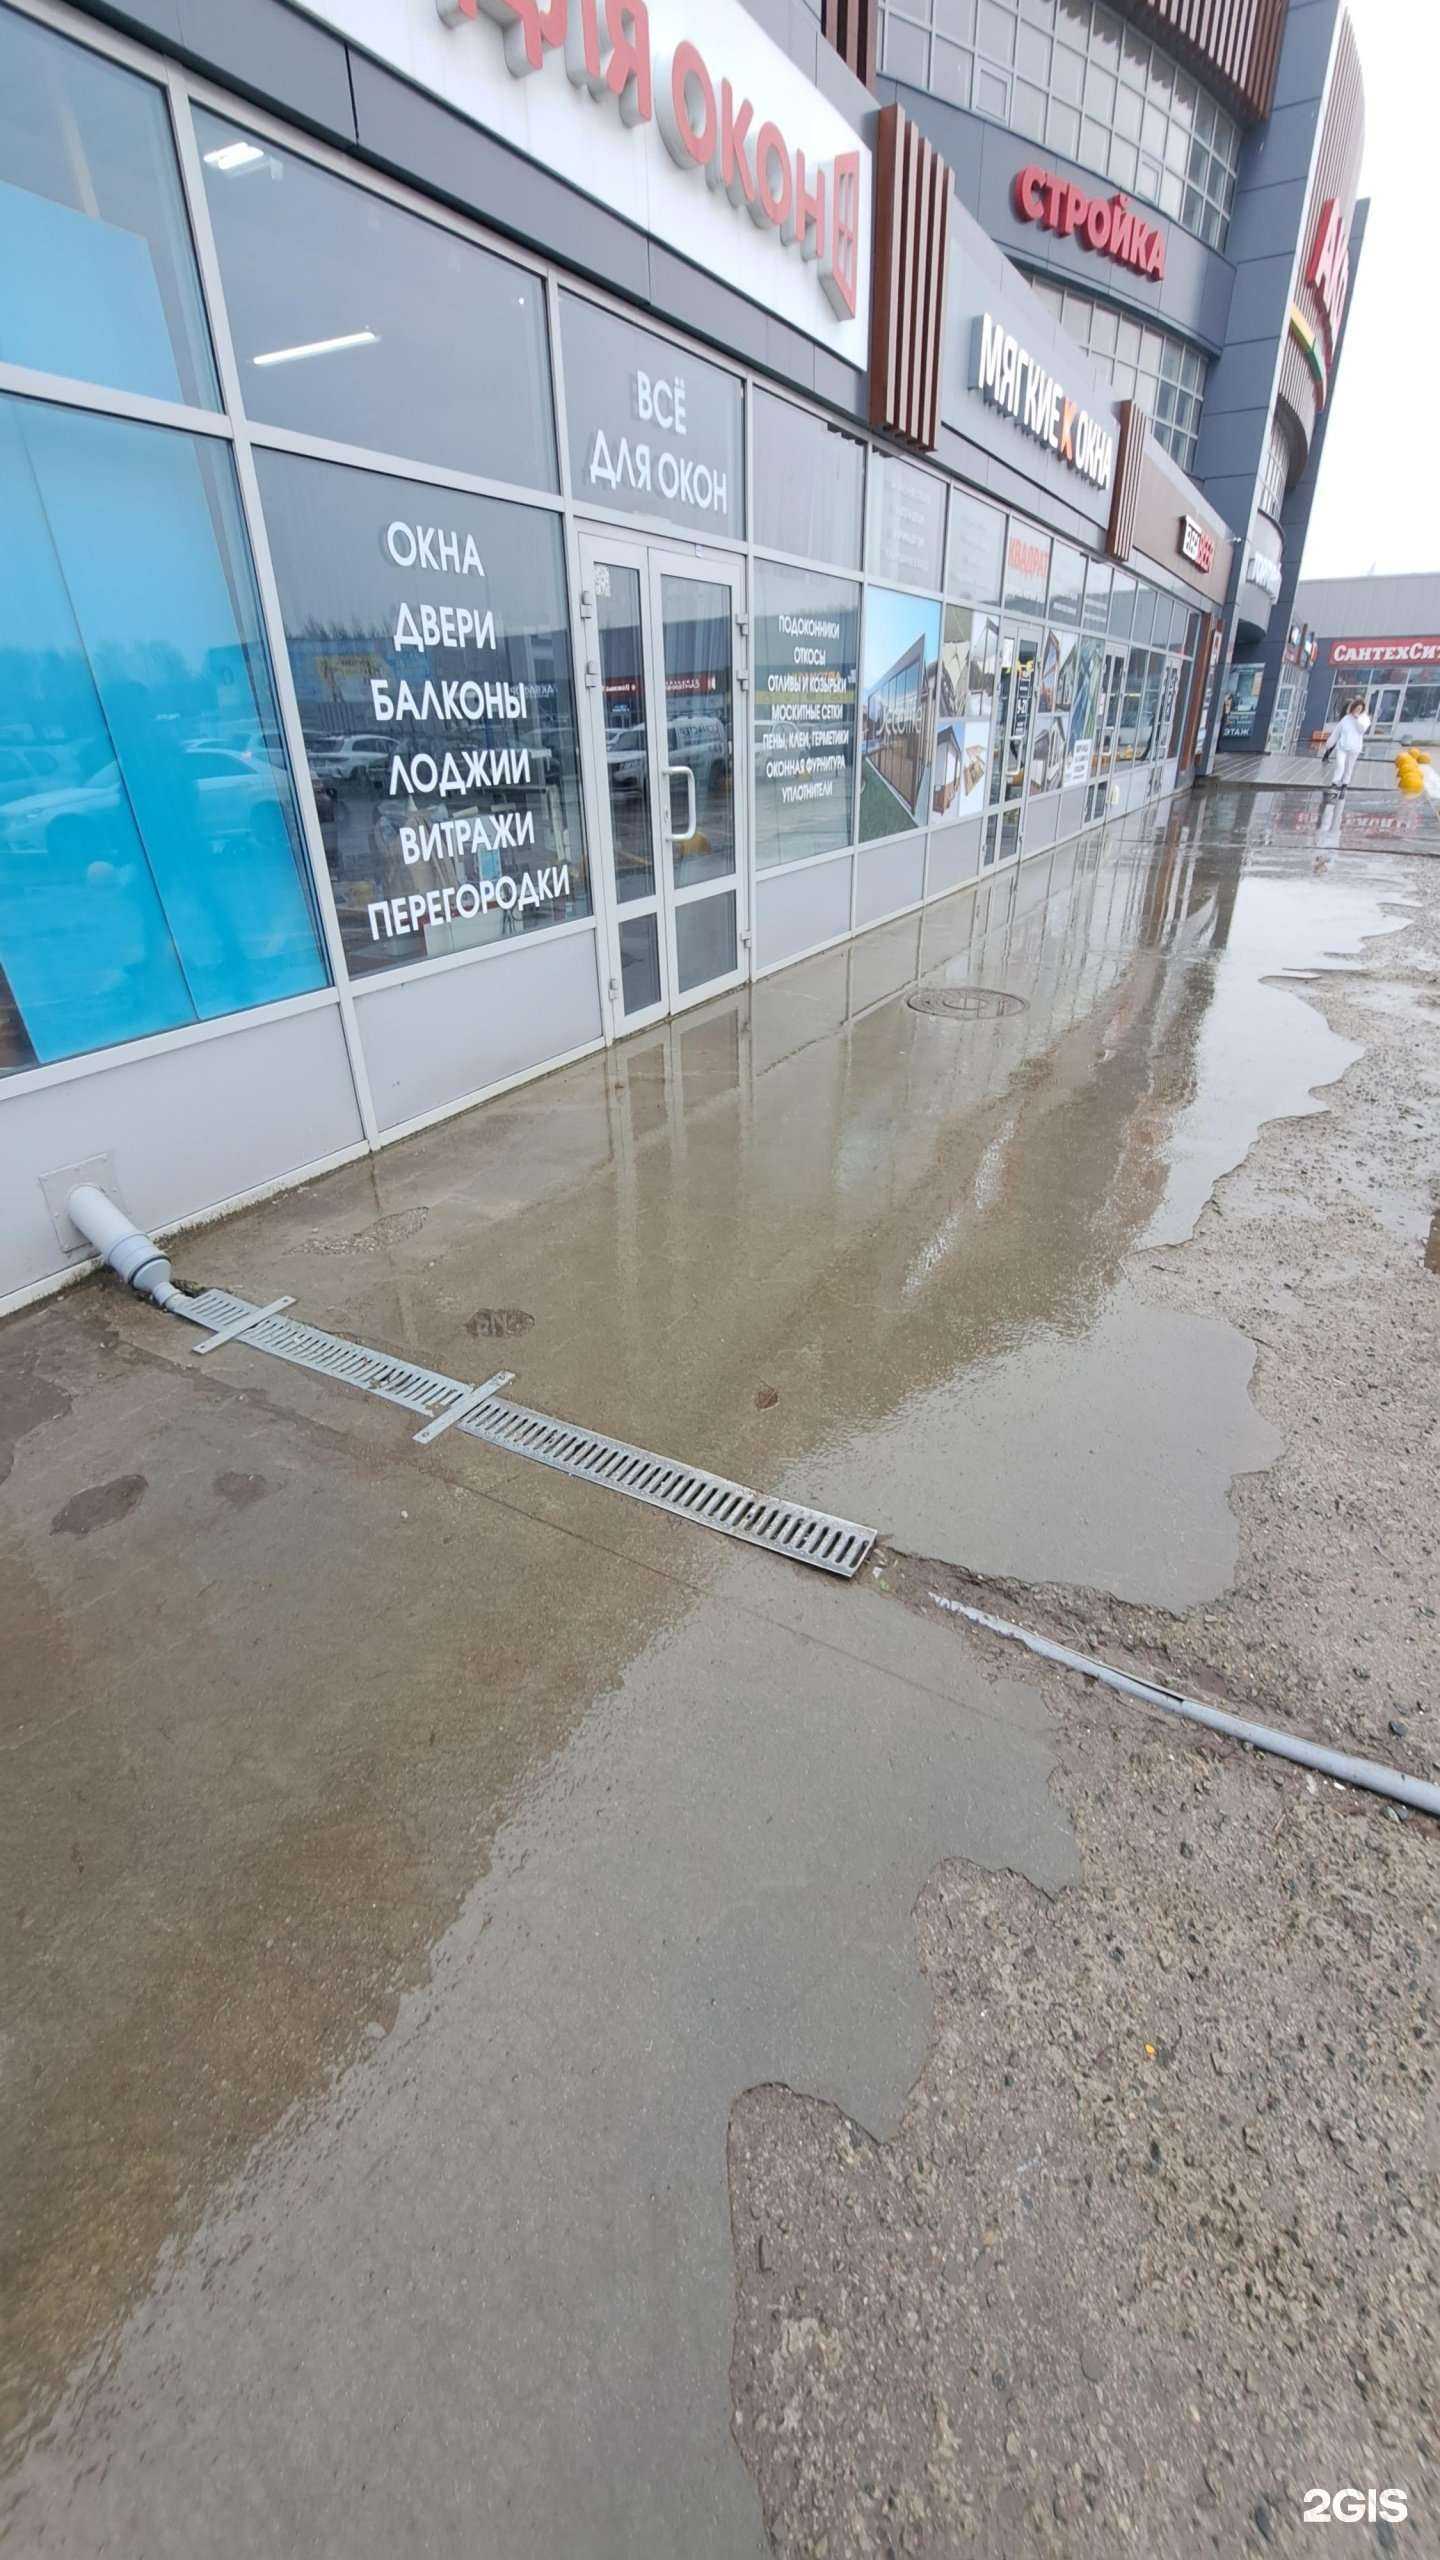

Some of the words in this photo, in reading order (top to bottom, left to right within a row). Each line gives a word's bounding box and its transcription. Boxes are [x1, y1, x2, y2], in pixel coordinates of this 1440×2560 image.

[668, 40, 826, 260] ОКОН
[1016, 163, 1166, 281] СТРОЙКА
[637, 369, 688, 435] ВСЁ
[978, 312, 1063, 449] МЯГКИЕ
[1075, 410, 1113, 490] ОКНА
[590, 428, 651, 493] ДЛЯ
[658, 454, 729, 515] ОКОН
[386, 521, 485, 577] ОКНА
[393, 602, 496, 652] ДВЕРИ
[778, 616, 840, 639] ПОДОКОННИКИ
[793, 646, 826, 666] ОТКОСЫ
[370, 679, 527, 721] БАЛКОНЫ
[768, 674, 801, 693] ОТЛИВЫ
[809, 677, 847, 694] КОЗЫРЬКИ
[771, 705, 820, 721] МОСКИТНЫЕ
[821, 704, 843, 720] СЕТКИ
[811, 730, 849, 747] ГЕРМЕТИКИ
[389, 748, 531, 797] ЛОДЖИИ
[766, 759, 805, 778] ОКОННАЯ
[806, 754, 846, 774] ФУРНИТУРА
[782, 781, 833, 803] УПЛОТНИТЕЛИ
[399, 810, 535, 866] ВИТРАЖИ
[367, 865, 571, 941] ПЕРЕГОРОДКИ
